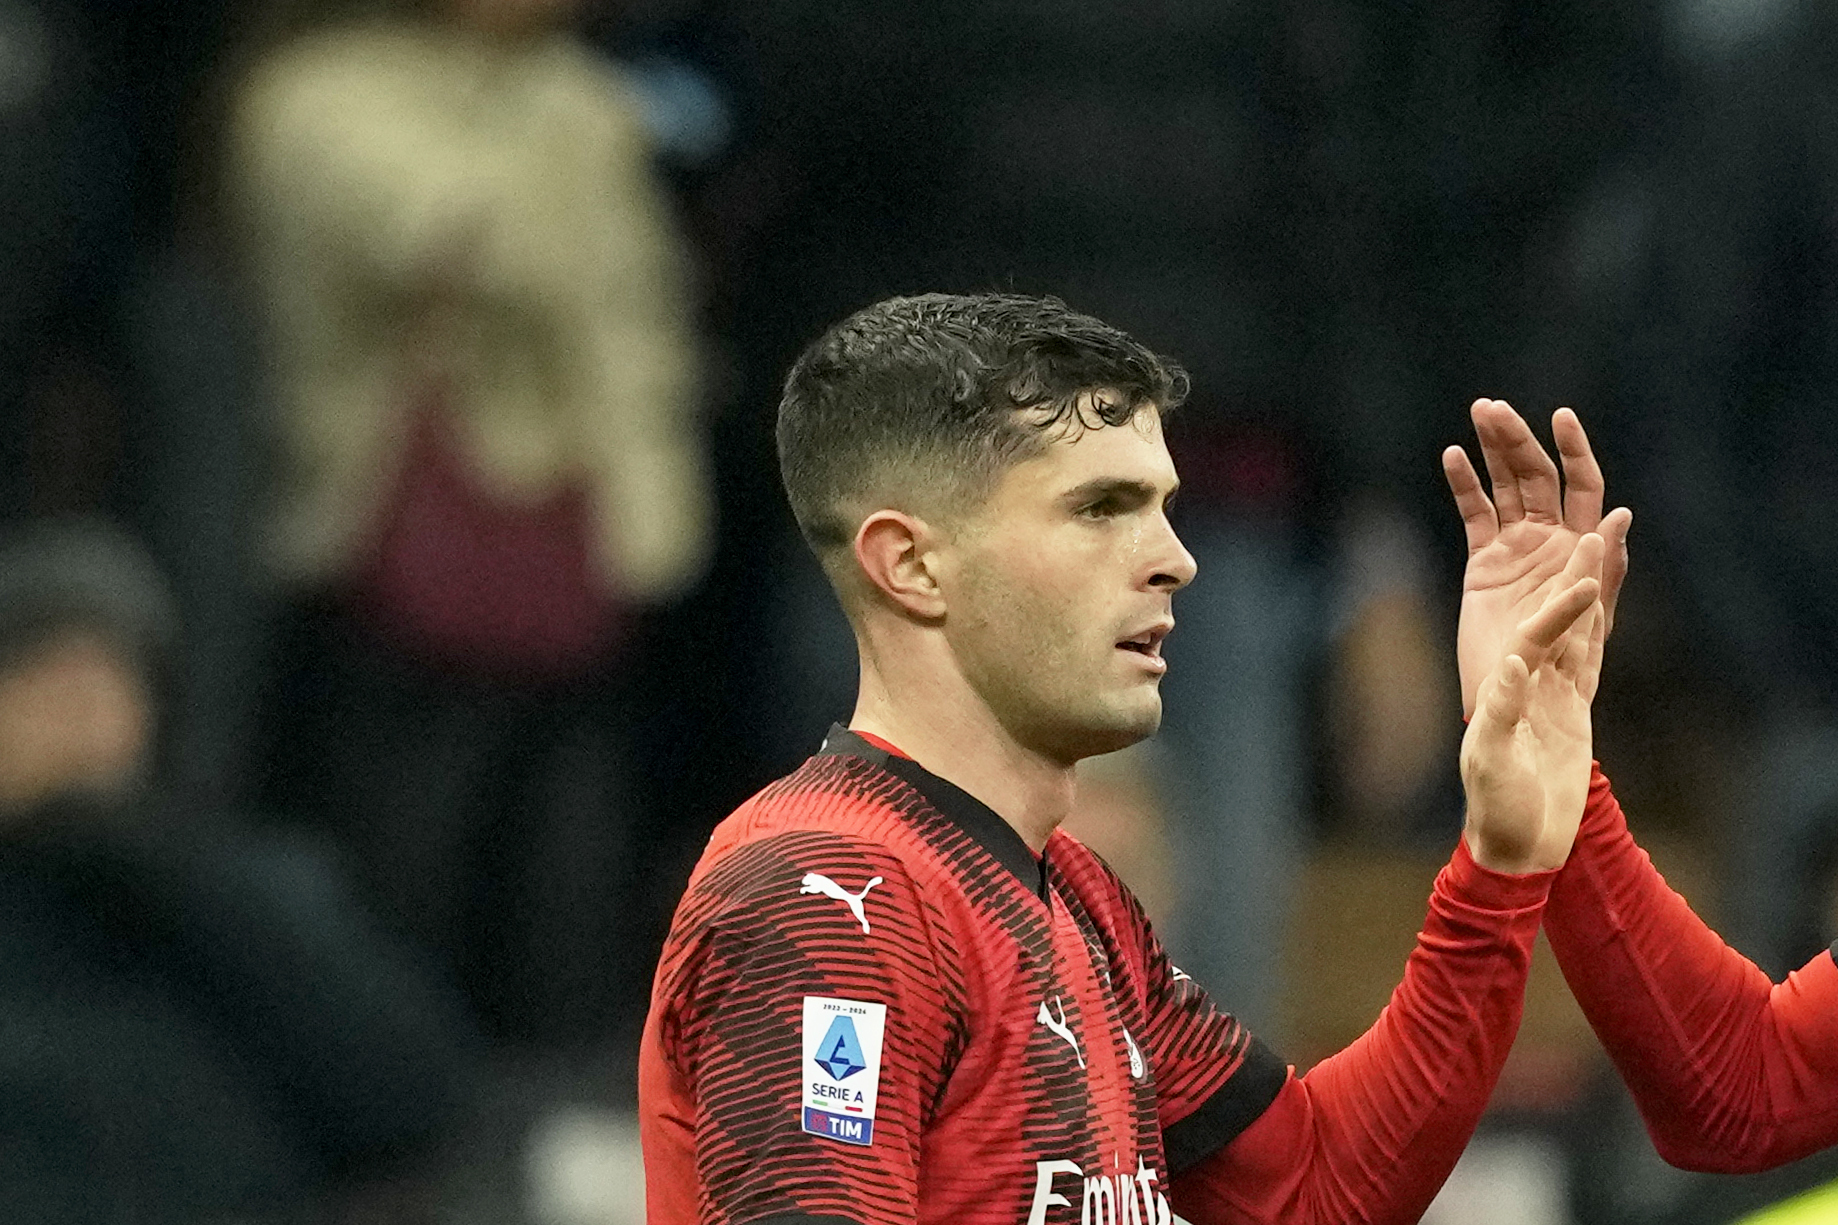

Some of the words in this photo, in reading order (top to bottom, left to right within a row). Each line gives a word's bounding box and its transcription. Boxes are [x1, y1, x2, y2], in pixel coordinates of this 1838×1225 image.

[812, 1082, 850, 1101] SERIE
[853, 1090, 864, 1104] A
[829, 1116, 863, 1140] TIM
